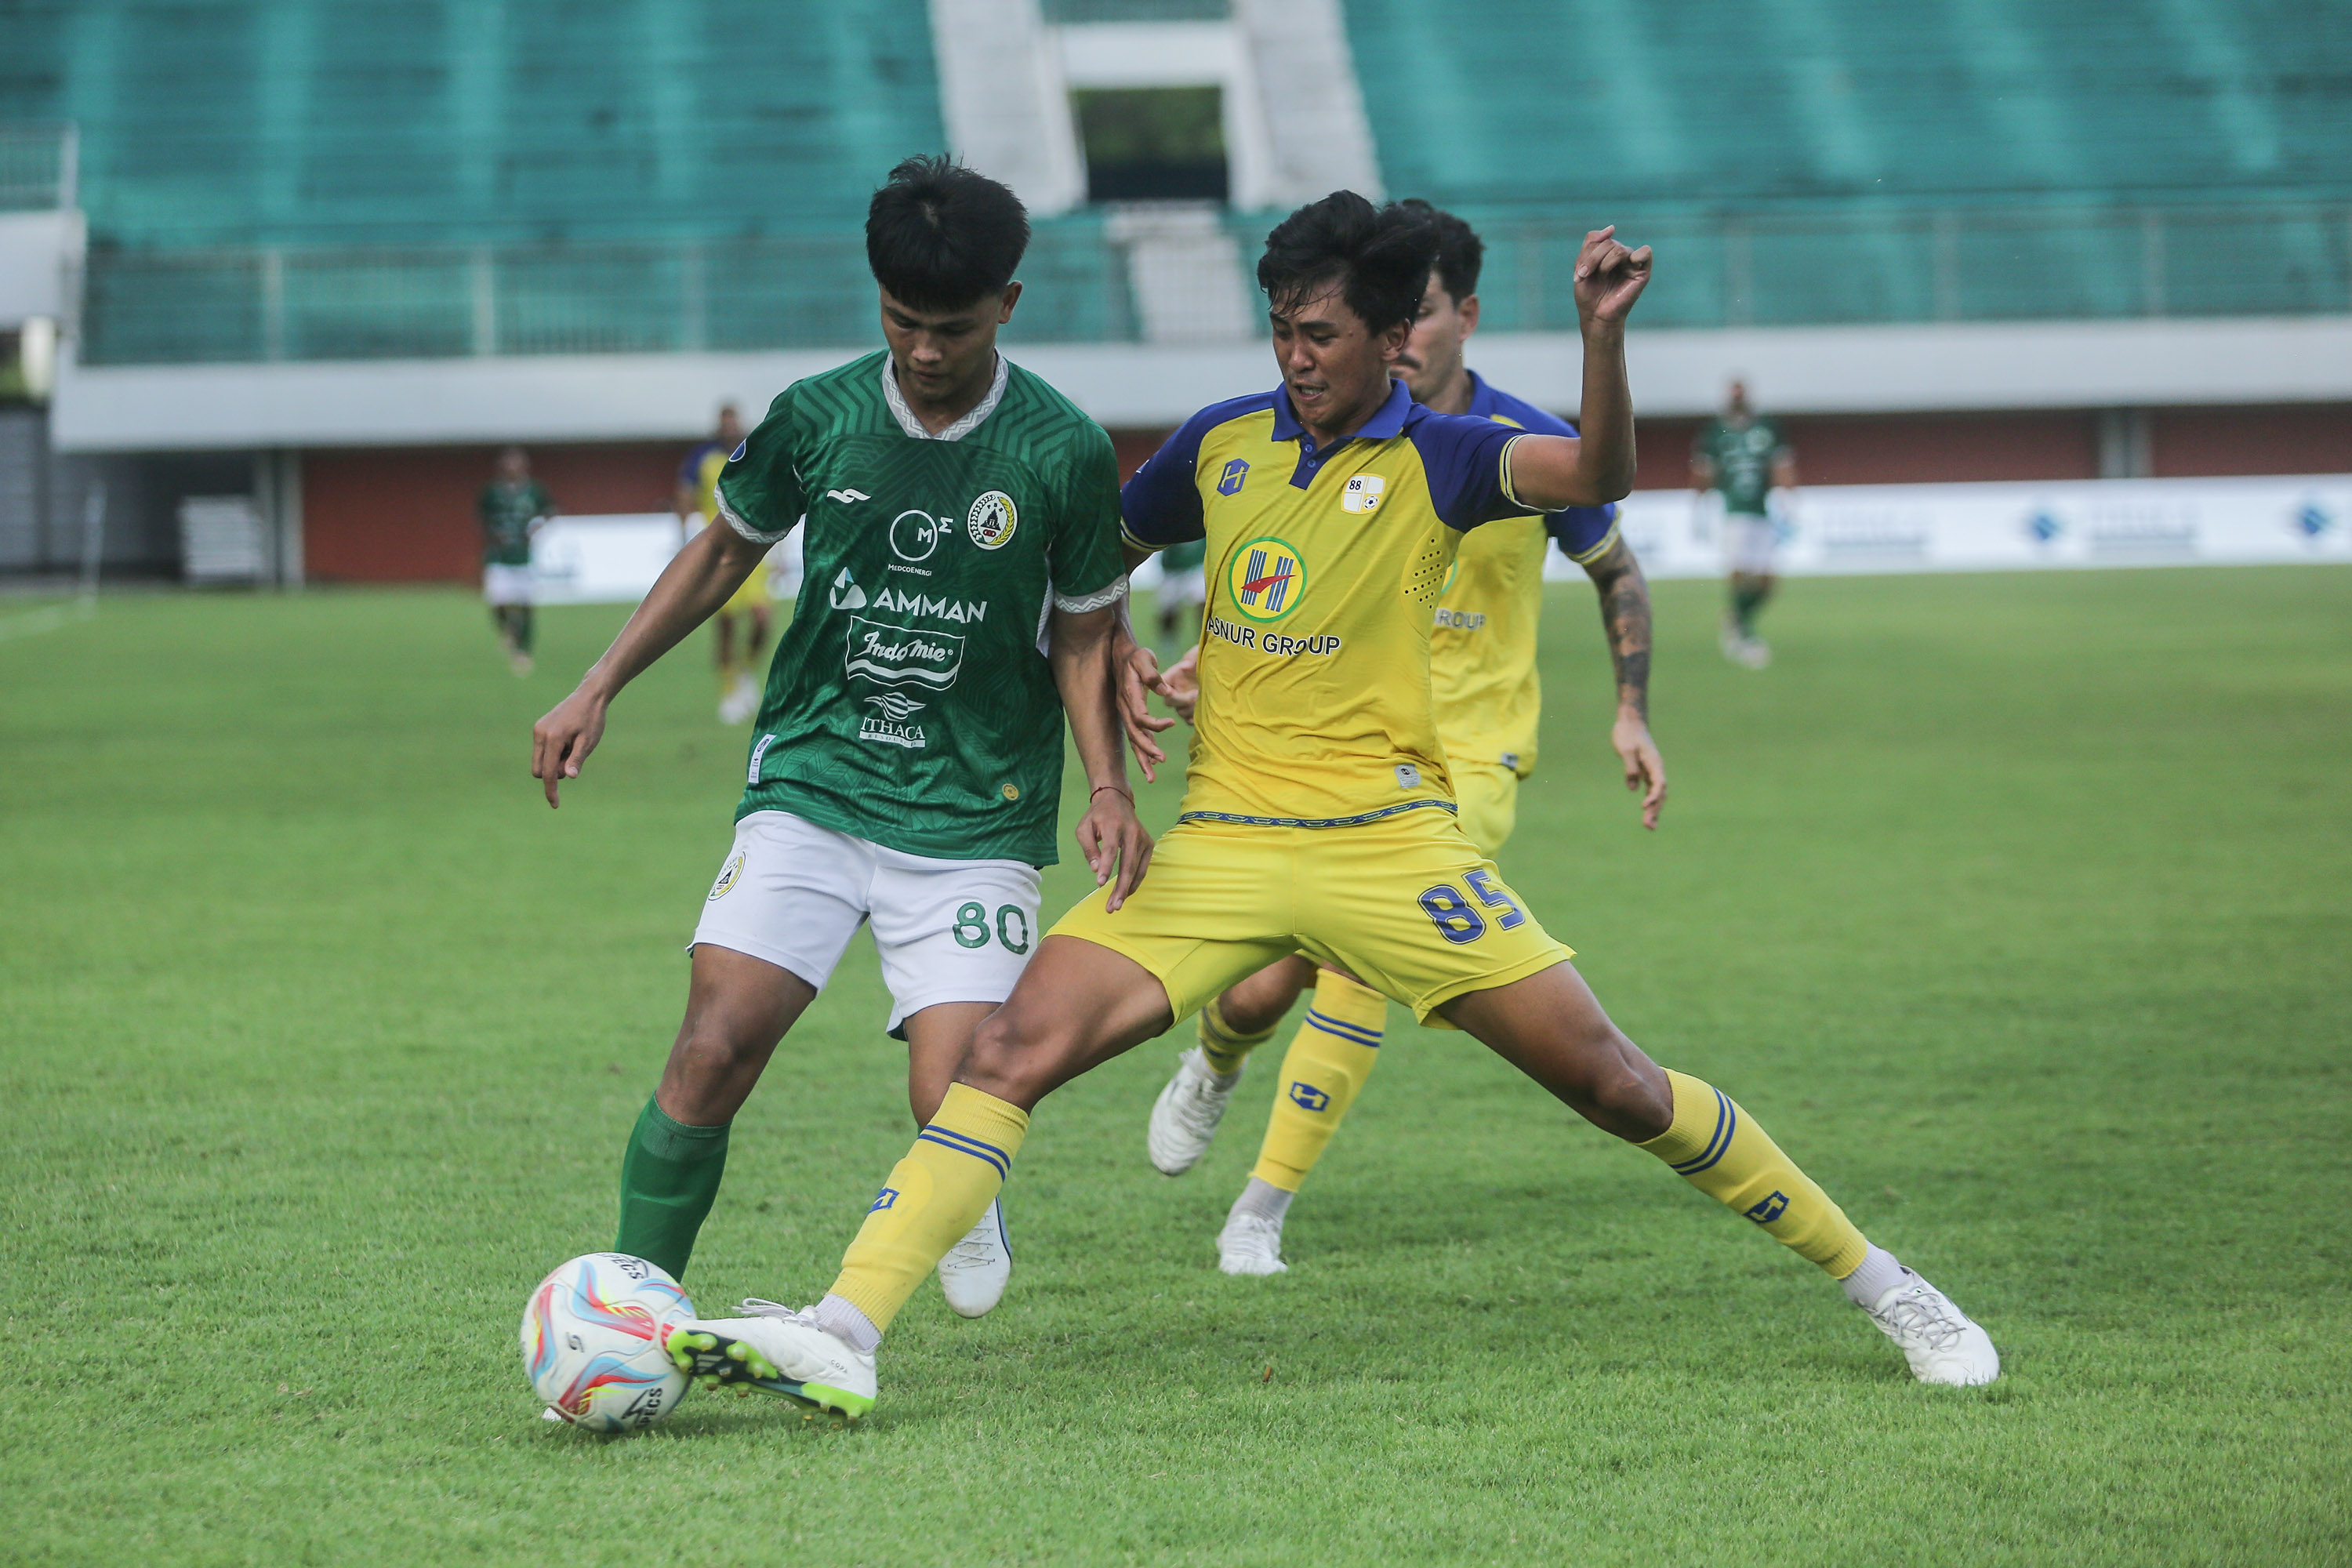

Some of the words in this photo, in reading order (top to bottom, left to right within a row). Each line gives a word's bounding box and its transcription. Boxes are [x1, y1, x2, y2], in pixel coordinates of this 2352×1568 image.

[1349, 480, 1362, 490] 88
[873, 587, 987, 623] AMMAN
[1436, 608, 1486, 630] ROUP
[1207, 615, 1256, 649] ASNUR
[1262, 633, 1341, 656] GROUP
[860, 717, 925, 739] ITHACA
[1417, 869, 1526, 945] 85
[952, 902, 1029, 955] 80
[597, 1254, 644, 1279] PECS
[636, 1388, 663, 1428] PECS
